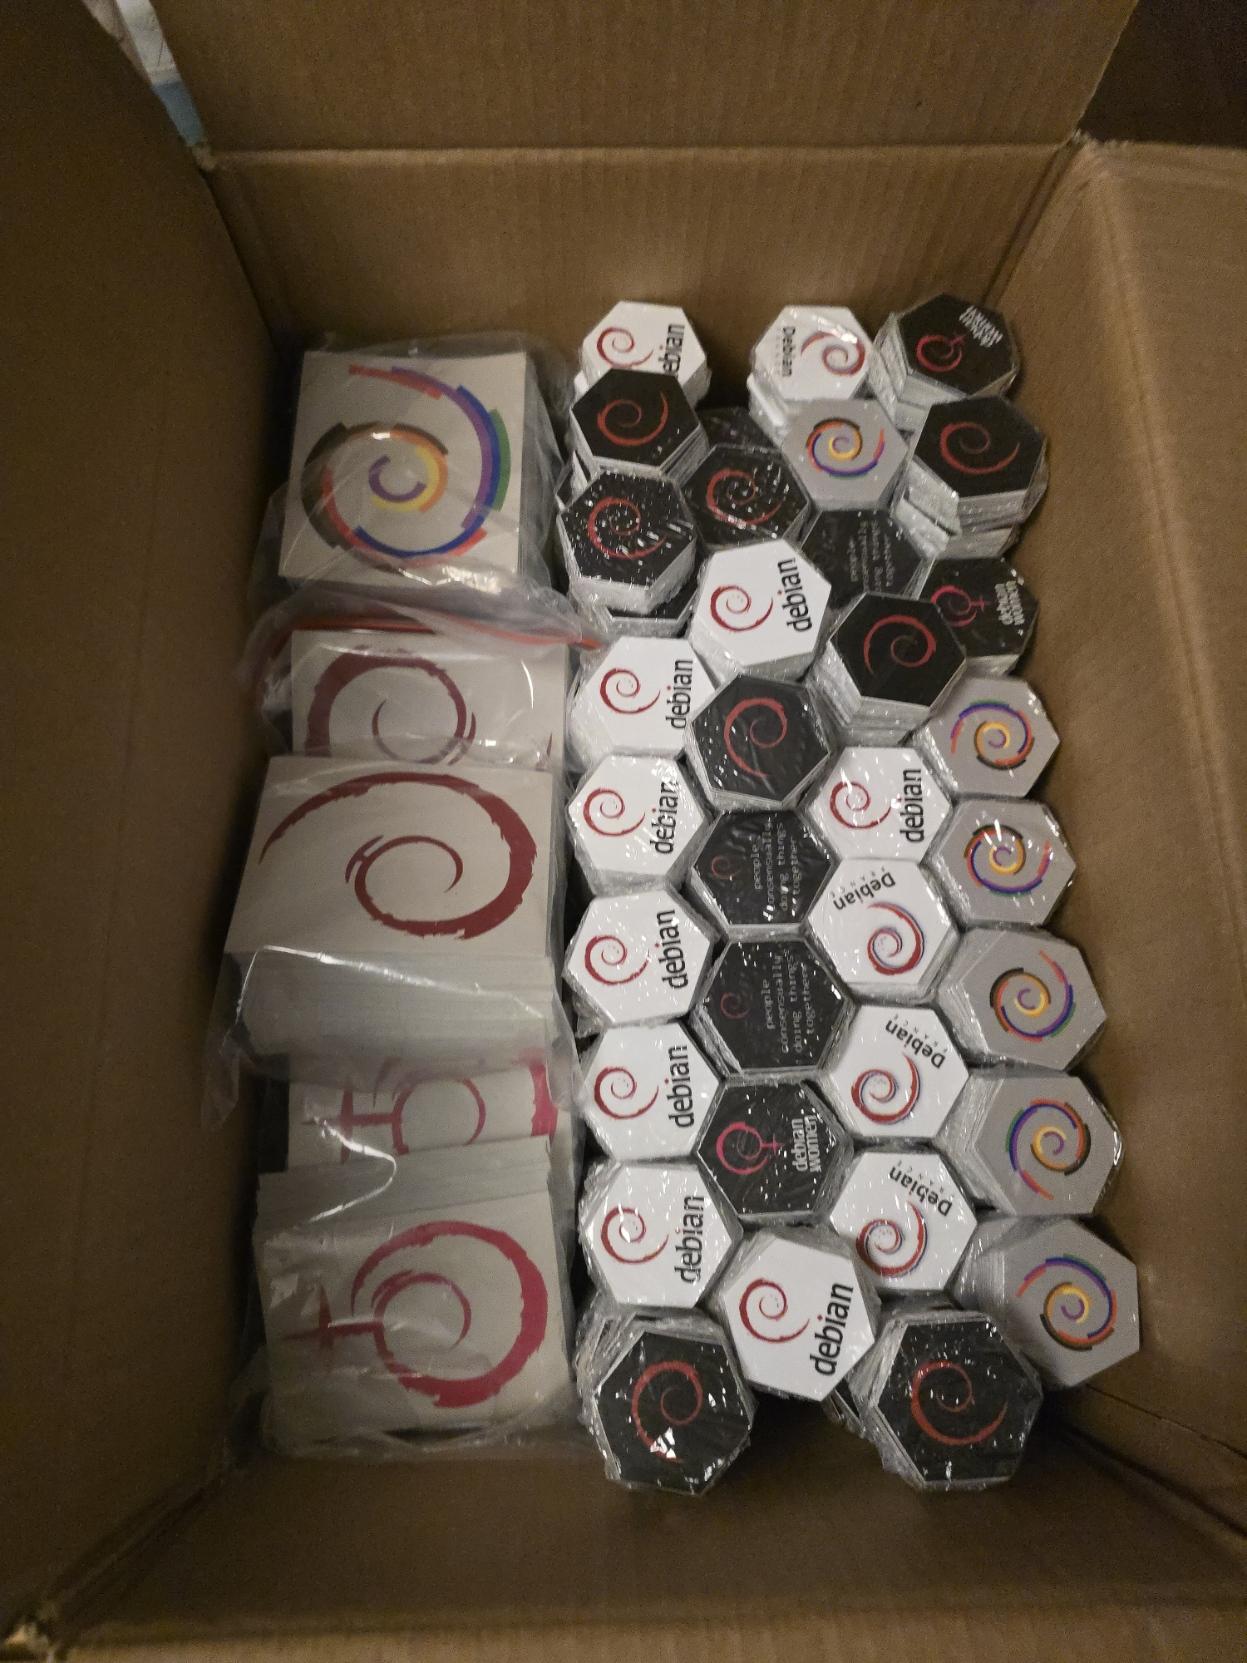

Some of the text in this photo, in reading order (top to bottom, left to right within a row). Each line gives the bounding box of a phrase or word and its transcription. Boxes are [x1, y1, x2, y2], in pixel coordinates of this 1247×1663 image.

[658, 323, 686, 378] ebian
[782, 326, 796, 377] Debian
[777, 558, 813, 633] debian
[665, 659, 693, 730] debian
[650, 779, 679, 855] debian
[899, 768, 925, 843] debian
[832, 871, 897, 911] Debian
[654, 909, 689, 990] debian
[761, 978, 775, 1030] people
[792, 1010, 804, 1053] doing
[885, 1019, 946, 1069] Debian
[664, 1044, 695, 1128] debian
[791, 1118, 807, 1172] debian
[804, 1114, 821, 1173] women
[889, 1165, 953, 1217] Debian
[674, 1195, 705, 1284] debian
[809, 1282, 854, 1377] debian
